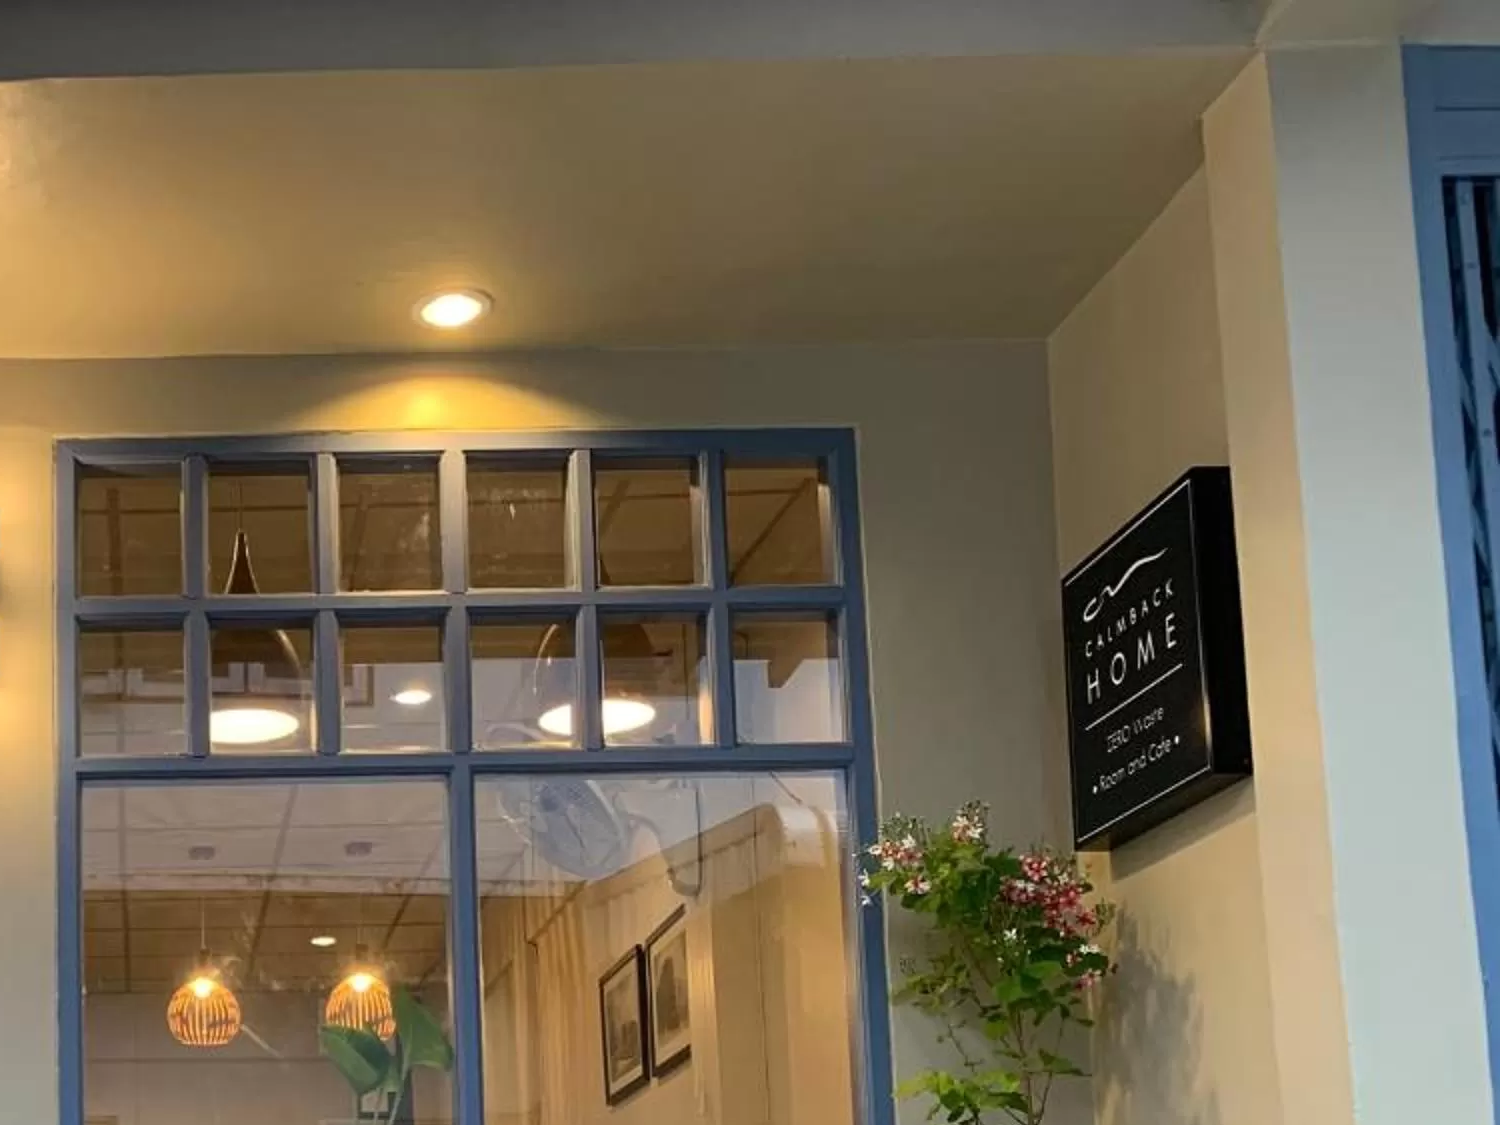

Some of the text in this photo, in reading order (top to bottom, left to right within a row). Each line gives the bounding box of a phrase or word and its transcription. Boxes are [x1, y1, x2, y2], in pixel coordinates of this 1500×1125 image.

[1087, 612, 1177, 704] HOME
[1100, 767, 1126, 791] Room
[1128, 748, 1148, 775] and
